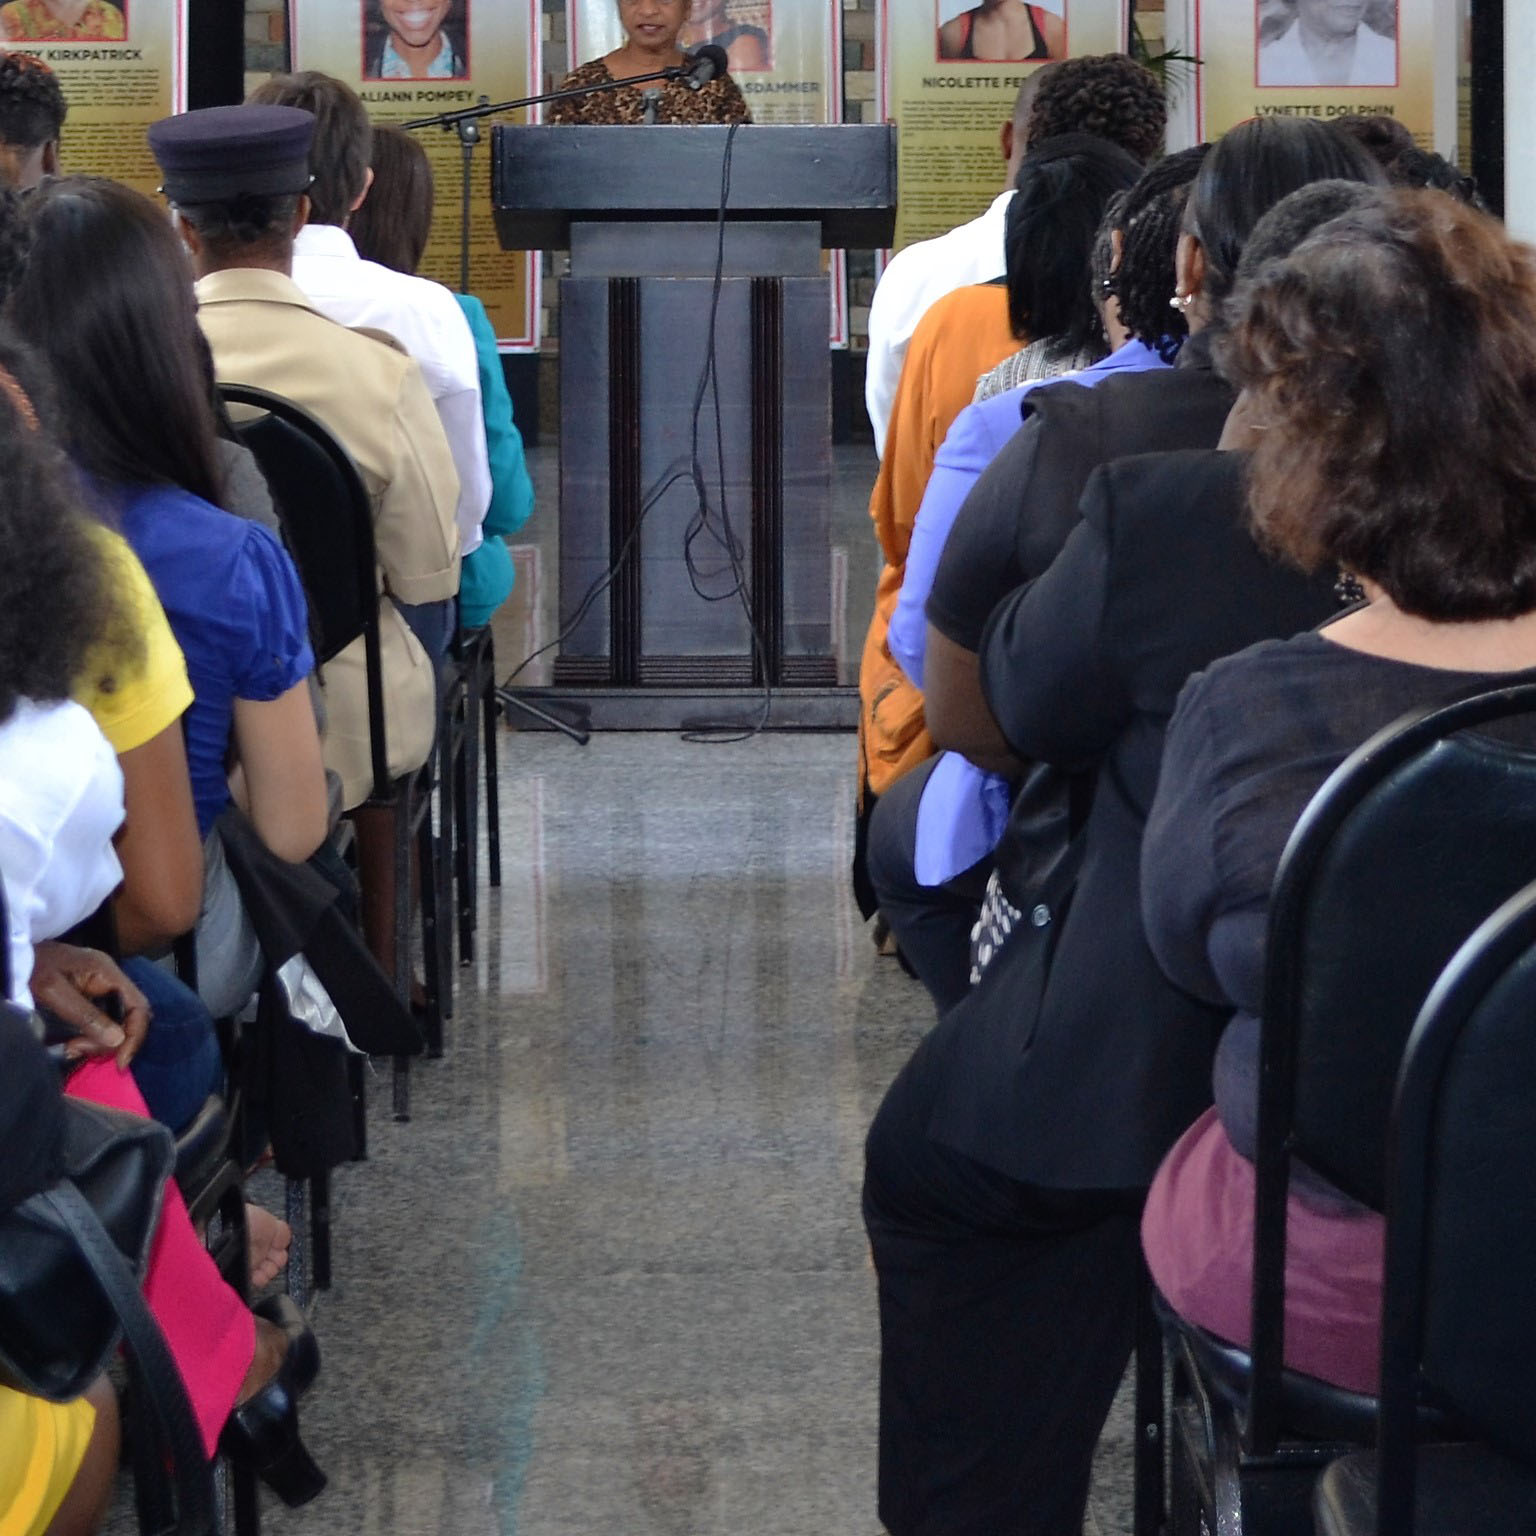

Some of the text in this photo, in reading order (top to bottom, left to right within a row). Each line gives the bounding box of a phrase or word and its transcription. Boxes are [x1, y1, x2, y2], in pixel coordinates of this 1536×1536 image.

[47, 48, 143, 61] KIRKPATRICK
[923, 77, 1000, 89] NICOLETTE
[361, 90, 474, 103] ALIANN POMPEY
[1255, 105, 1395, 117] LYNETTE DOLPHIN
